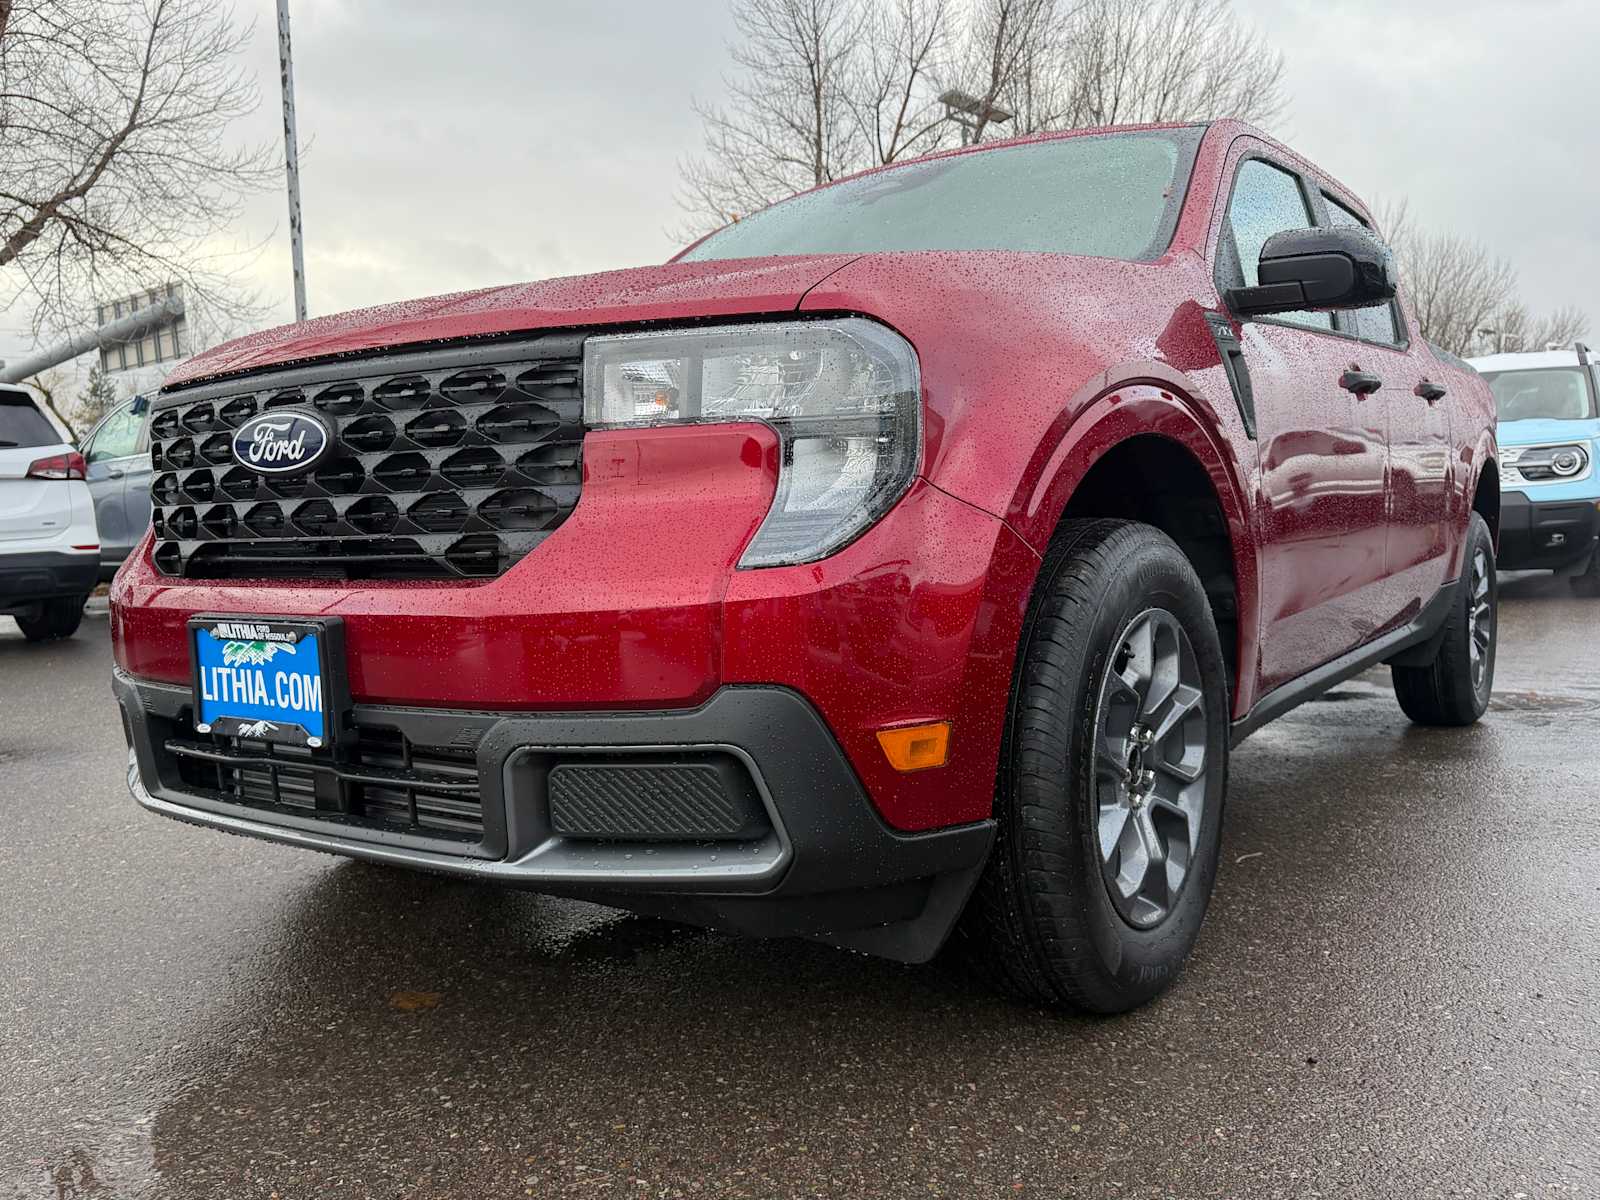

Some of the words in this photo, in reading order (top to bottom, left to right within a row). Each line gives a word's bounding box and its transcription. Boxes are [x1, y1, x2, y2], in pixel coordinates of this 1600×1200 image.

[249, 422, 306, 463] Ford
[226, 623, 259, 640] LITHIA
[200, 665, 323, 713] LITHIA.COM
